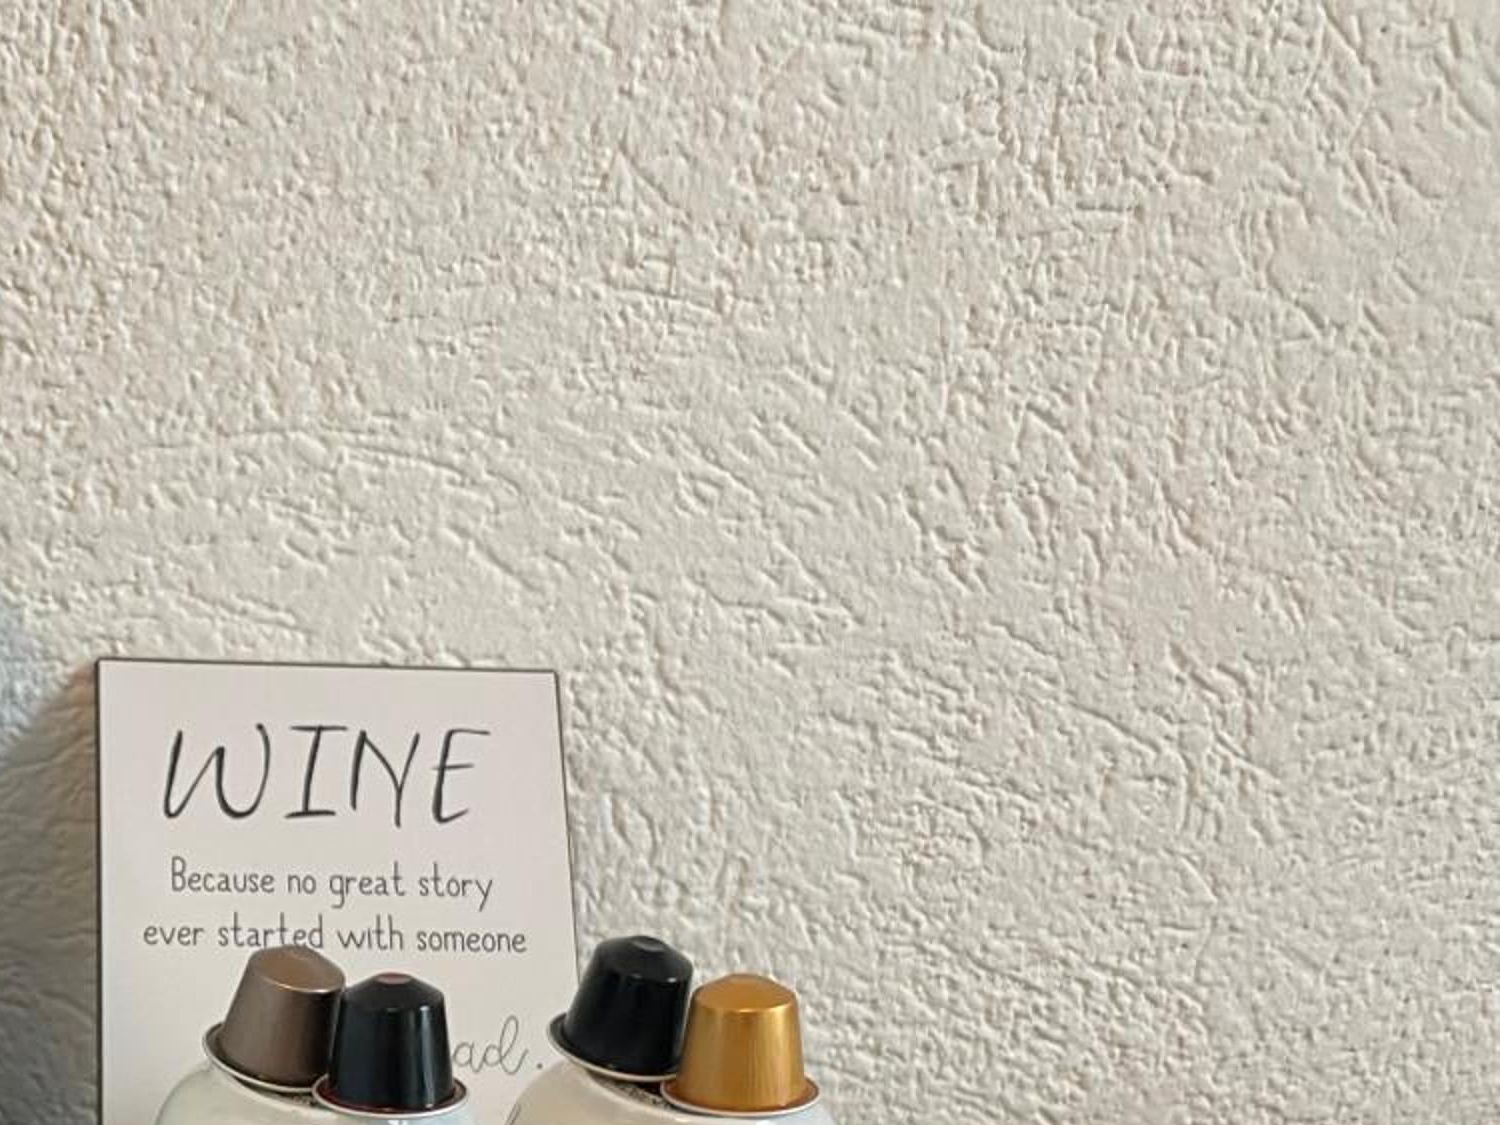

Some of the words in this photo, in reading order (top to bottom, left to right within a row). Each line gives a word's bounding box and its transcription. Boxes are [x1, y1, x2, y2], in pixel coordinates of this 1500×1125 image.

[162, 722, 492, 828] WINE
[171, 855, 276, 894] Because
[287, 872, 317, 895] no
[329, 861, 406, 910] great
[418, 862, 494, 912] story
[143, 924, 205, 947] ever
[217, 912, 324, 949] started
[337, 914, 405, 951] with
[416, 929, 528, 954] someone
[452, 1014, 544, 1076] ad.
